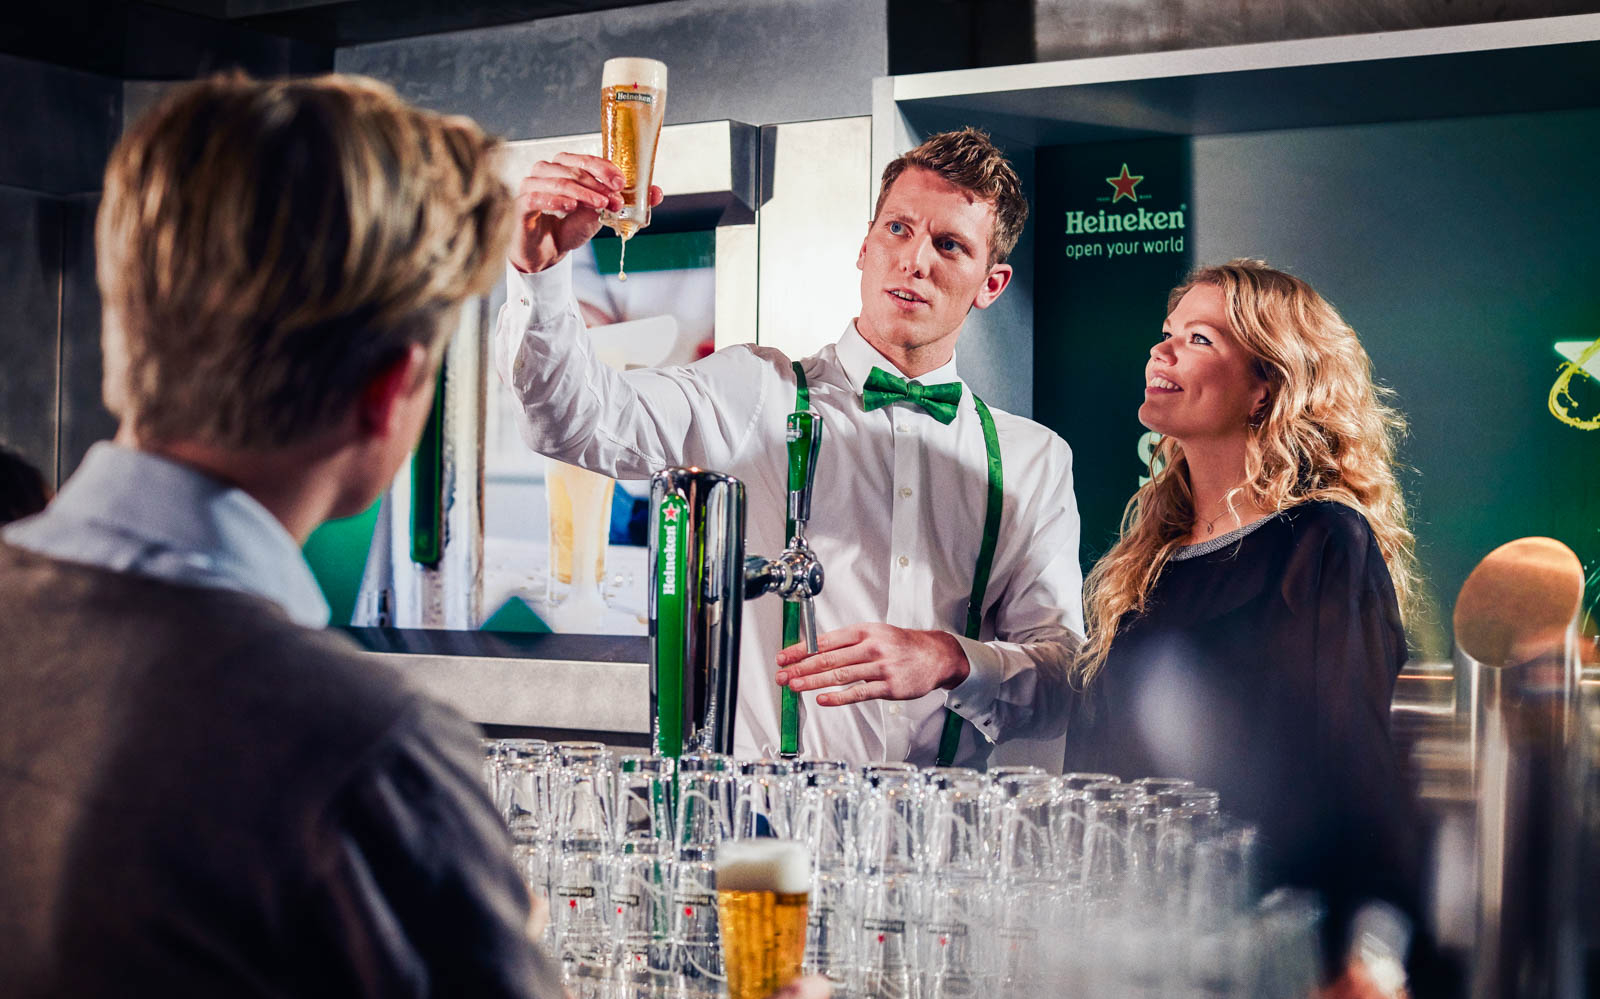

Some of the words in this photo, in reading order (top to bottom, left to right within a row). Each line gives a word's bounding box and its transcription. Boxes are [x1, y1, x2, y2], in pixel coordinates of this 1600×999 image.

[617, 92, 651, 102] Heineken
[1066, 243, 1102, 260] open
[1107, 241, 1139, 258] your
[1143, 236, 1184, 253] world
[662, 525, 677, 595] Heineken
